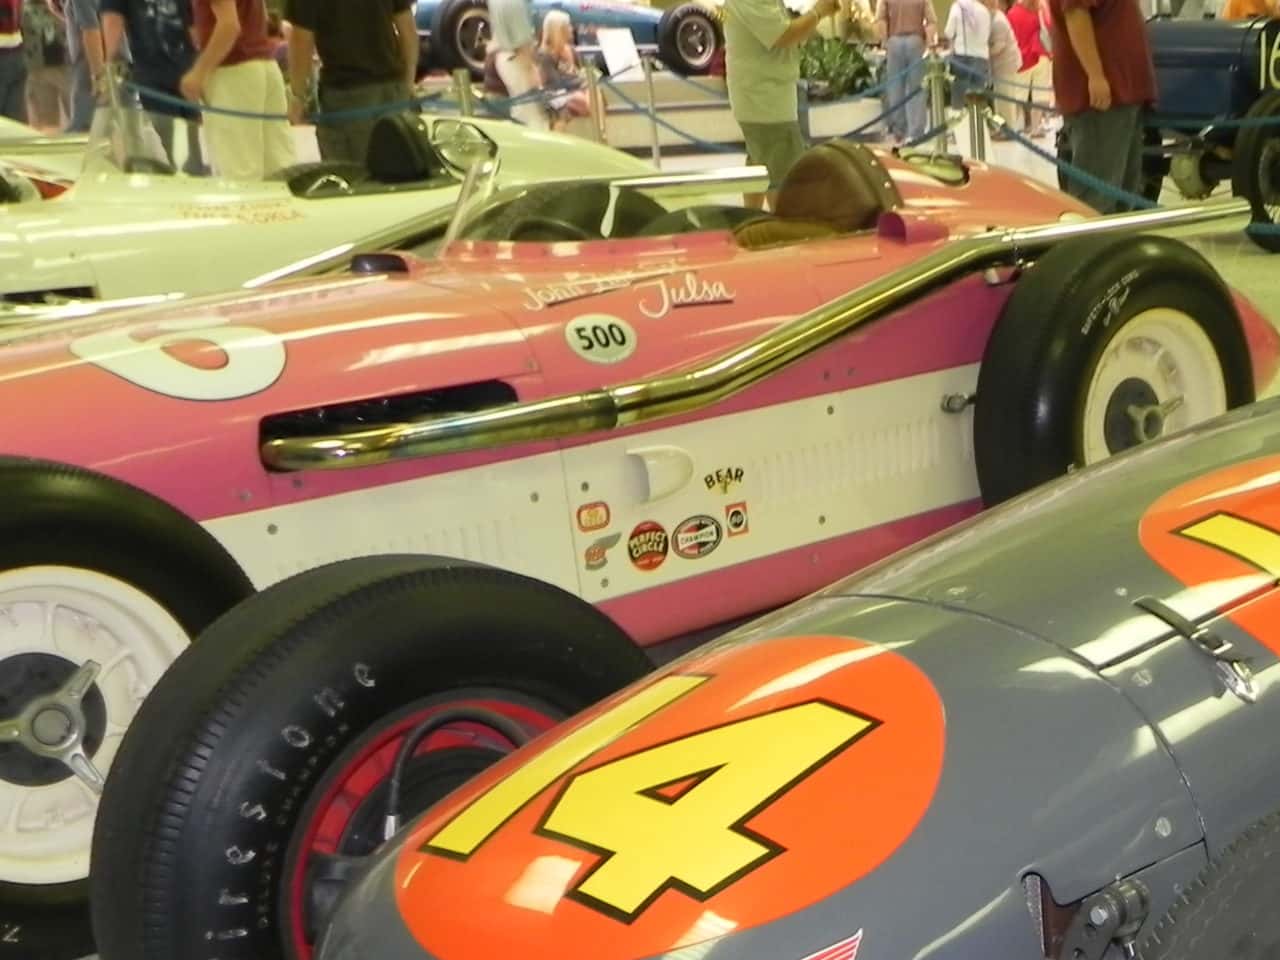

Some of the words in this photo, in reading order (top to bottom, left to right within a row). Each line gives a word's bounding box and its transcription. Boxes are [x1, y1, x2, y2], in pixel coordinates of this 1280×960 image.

[574, 323, 626, 351] 500
[704, 467, 744, 489] BEAR
[416, 672, 884, 926] 14
